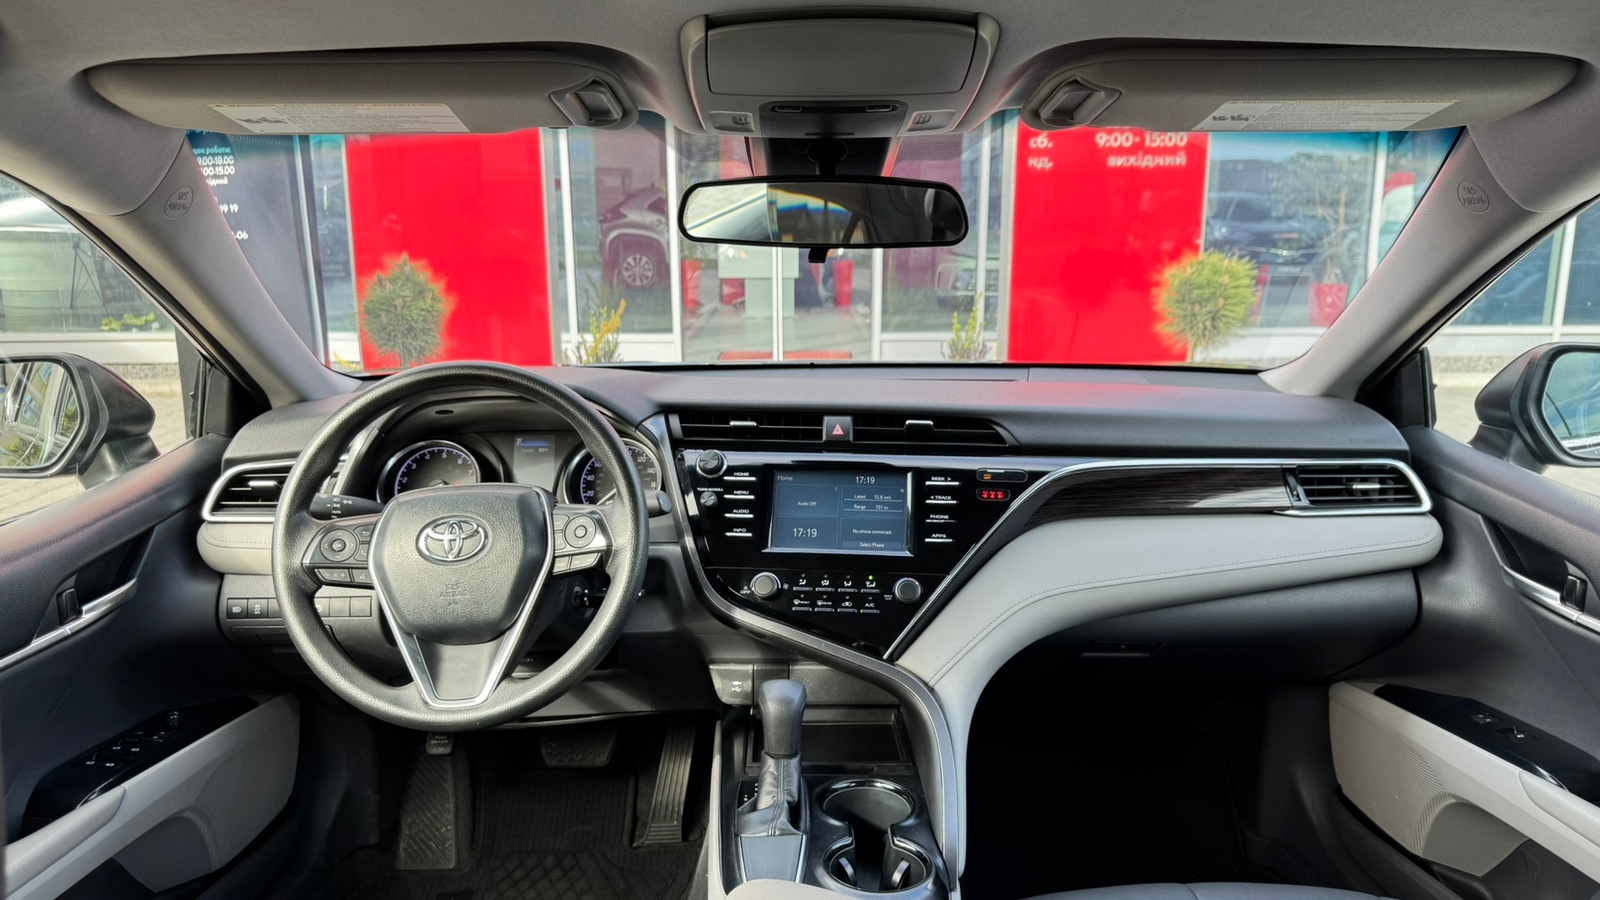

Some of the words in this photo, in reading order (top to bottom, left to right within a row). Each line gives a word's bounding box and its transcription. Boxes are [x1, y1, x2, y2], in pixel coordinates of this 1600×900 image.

[1106, 151, 1187, 168] вихідний
[229, 203, 239, 213] 19
[855, 476, 875, 484] 17:19
[792, 527, 818, 538] 17:19
